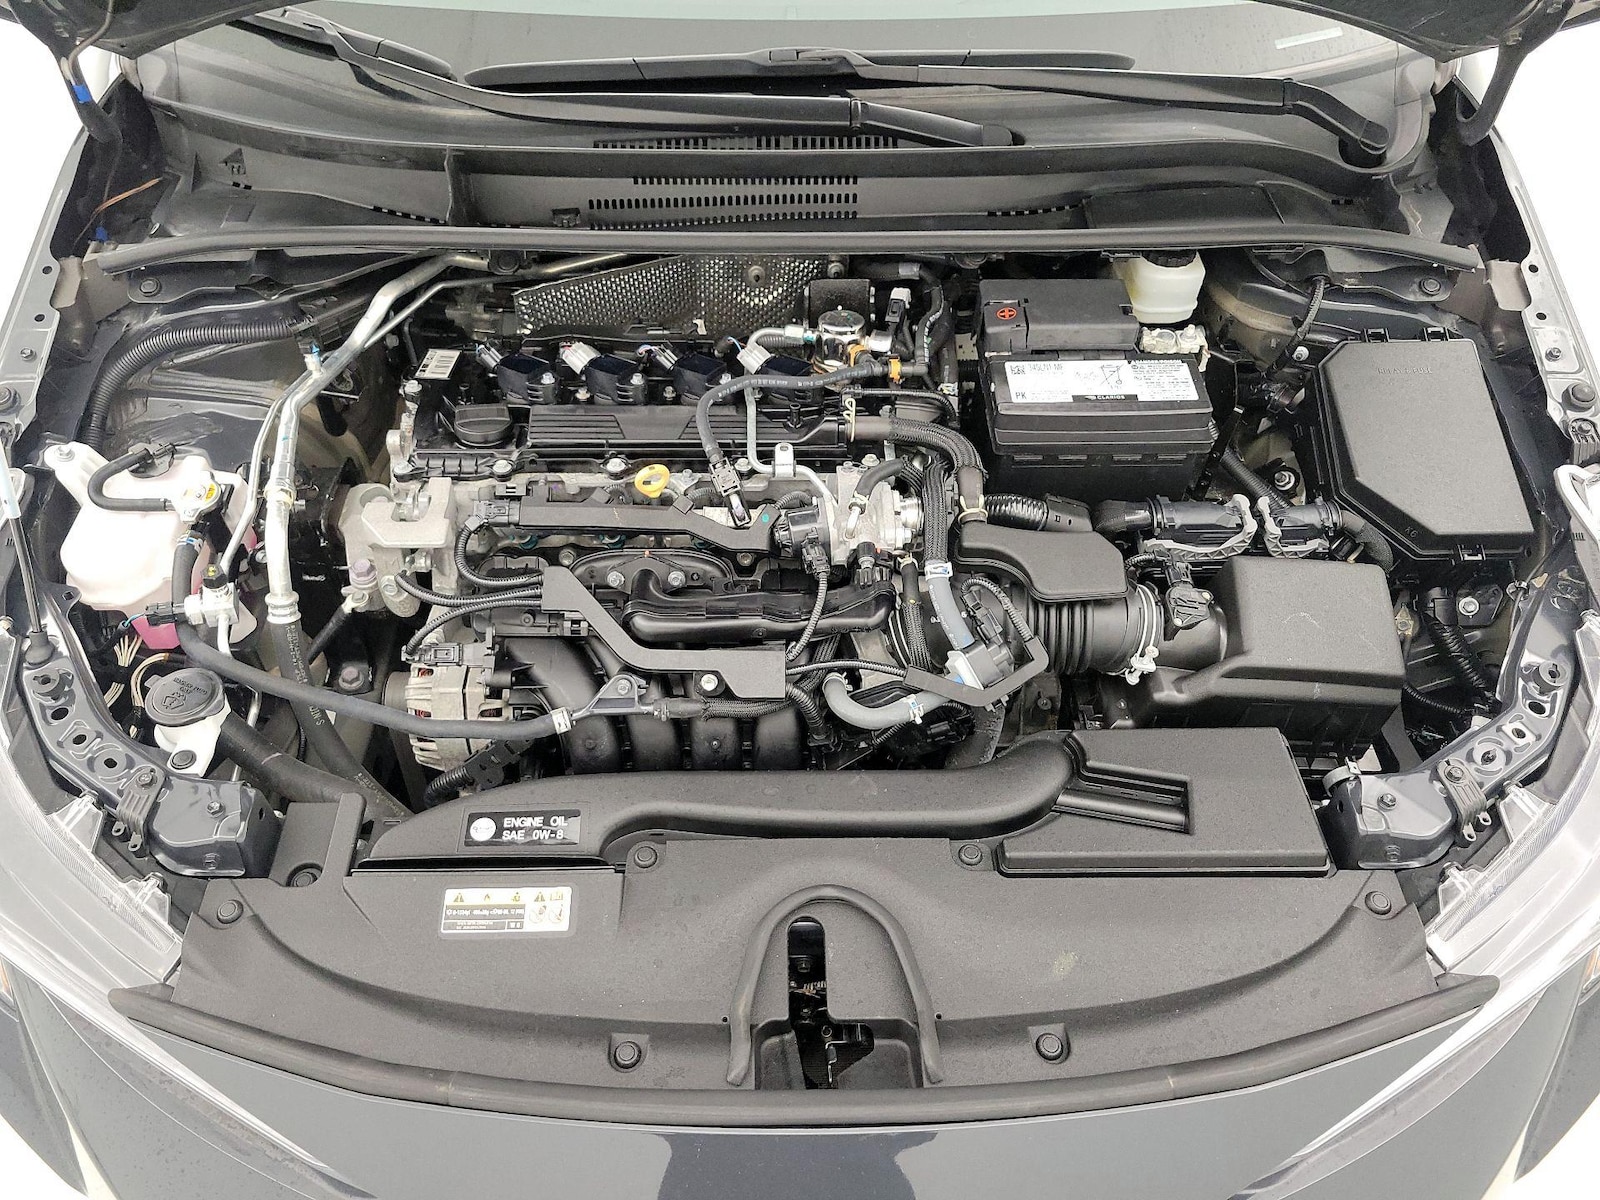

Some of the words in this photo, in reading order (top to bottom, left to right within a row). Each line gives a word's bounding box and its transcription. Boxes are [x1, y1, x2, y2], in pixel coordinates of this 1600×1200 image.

[1015, 391, 1027, 400] PK
[503, 816, 544, 828] ENGINE
[550, 816, 568, 827] OIL
[502, 830, 526, 841] SAE
[532, 829, 564, 840] 0W-8
